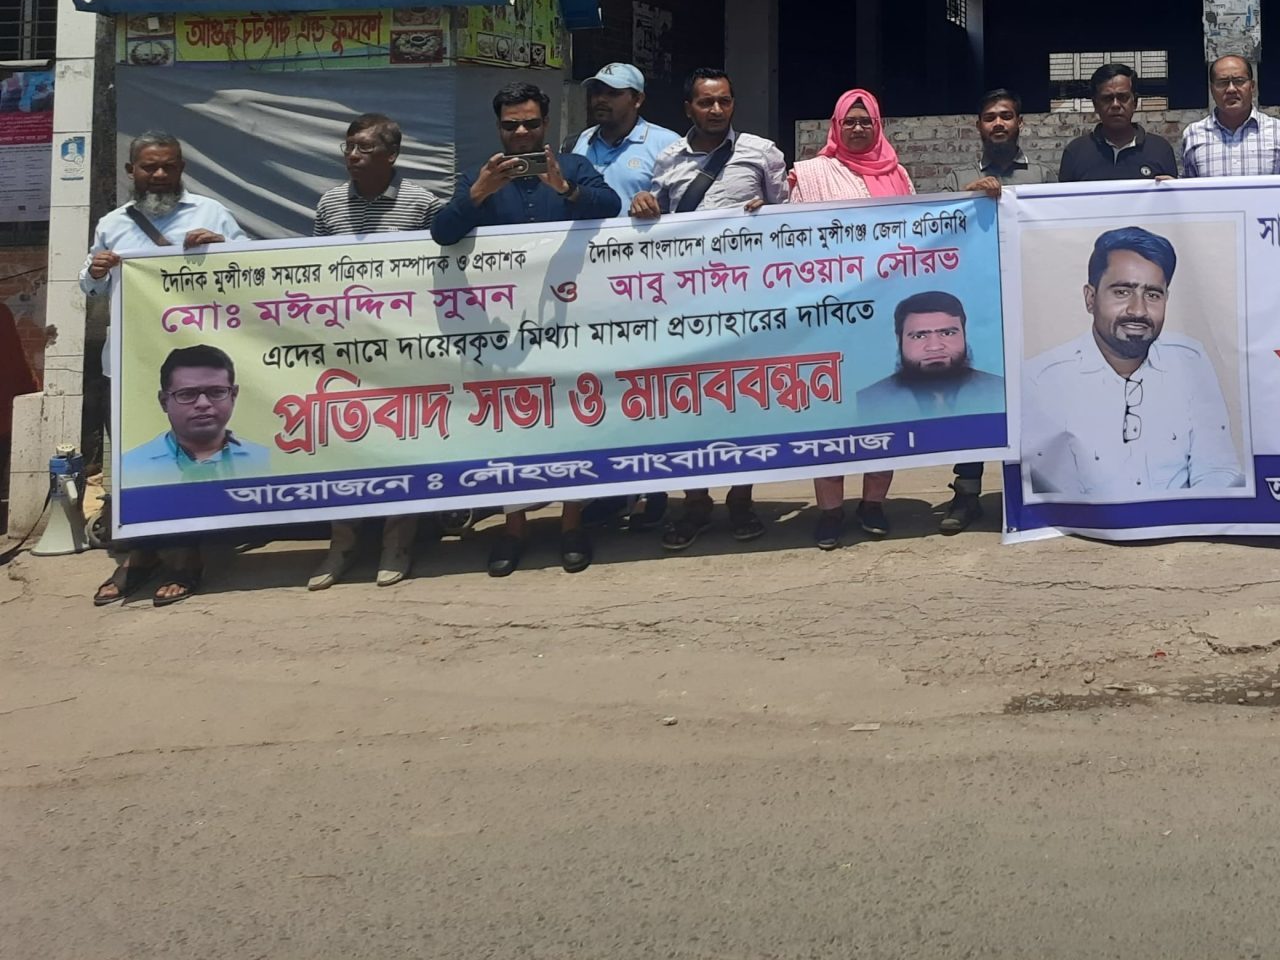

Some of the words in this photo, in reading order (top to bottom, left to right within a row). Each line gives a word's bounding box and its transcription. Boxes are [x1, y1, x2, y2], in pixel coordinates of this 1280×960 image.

[162, 266, 207, 293] দৈনিক
[213, 262, 266, 294] মুন্সীগঞ্জ
[271, 262, 321, 287] সময়ের
[328, 256, 383, 283] পত্রিকার
[389, 253, 449, 278] সম্পাদক
[456, 255, 470, 272] ও
[473, 249, 527, 272] প্রকাশক
[589, 238, 634, 265] দৈনিক
[639, 235, 705, 260] বাংলাদেশ
[711, 227, 763, 254] প্রতিদিন
[769, 224, 812, 248] পত্রিকা
[818, 221, 867, 250] মুন্সীগঞ্জ
[872, 218, 907, 241] জেলা
[912, 211, 968, 236] প্রতিনিধি
[161, 293, 243, 335] মোঃ
[254, 283, 416, 329] মঈনুদ্দিন
[433, 281, 517, 321] সুমন
[550, 280, 578, 304] ও
[607, 271, 668, 305] আবু
[677, 259, 751, 296] সাঈদ
[762, 253, 865, 288] দেওয়ান
[877, 245, 961, 280] সৌরভ
[262, 341, 327, 369] এদের
[336, 337, 388, 364] নামে
[396, 328, 509, 367] দায়েরকৃত
[519, 317, 579, 351] মিথ্যা
[588, 315, 658, 344] মামলা
[667, 305, 787, 341] প্রত্যাহারের
[796, 295, 876, 330] দাবিতে
[272, 367, 453, 457] প্রতিবাদ
[463, 374, 555, 437] সভা
[568, 371, 606, 428] ও
[615, 349, 845, 422] মানববন্ধন
[226, 474, 414, 506] আয়োজনে
[458, 458, 598, 489] লৌহজং
[609, 440, 780, 475] সাংবাদিক
[789, 430, 896, 458] সমাজ
